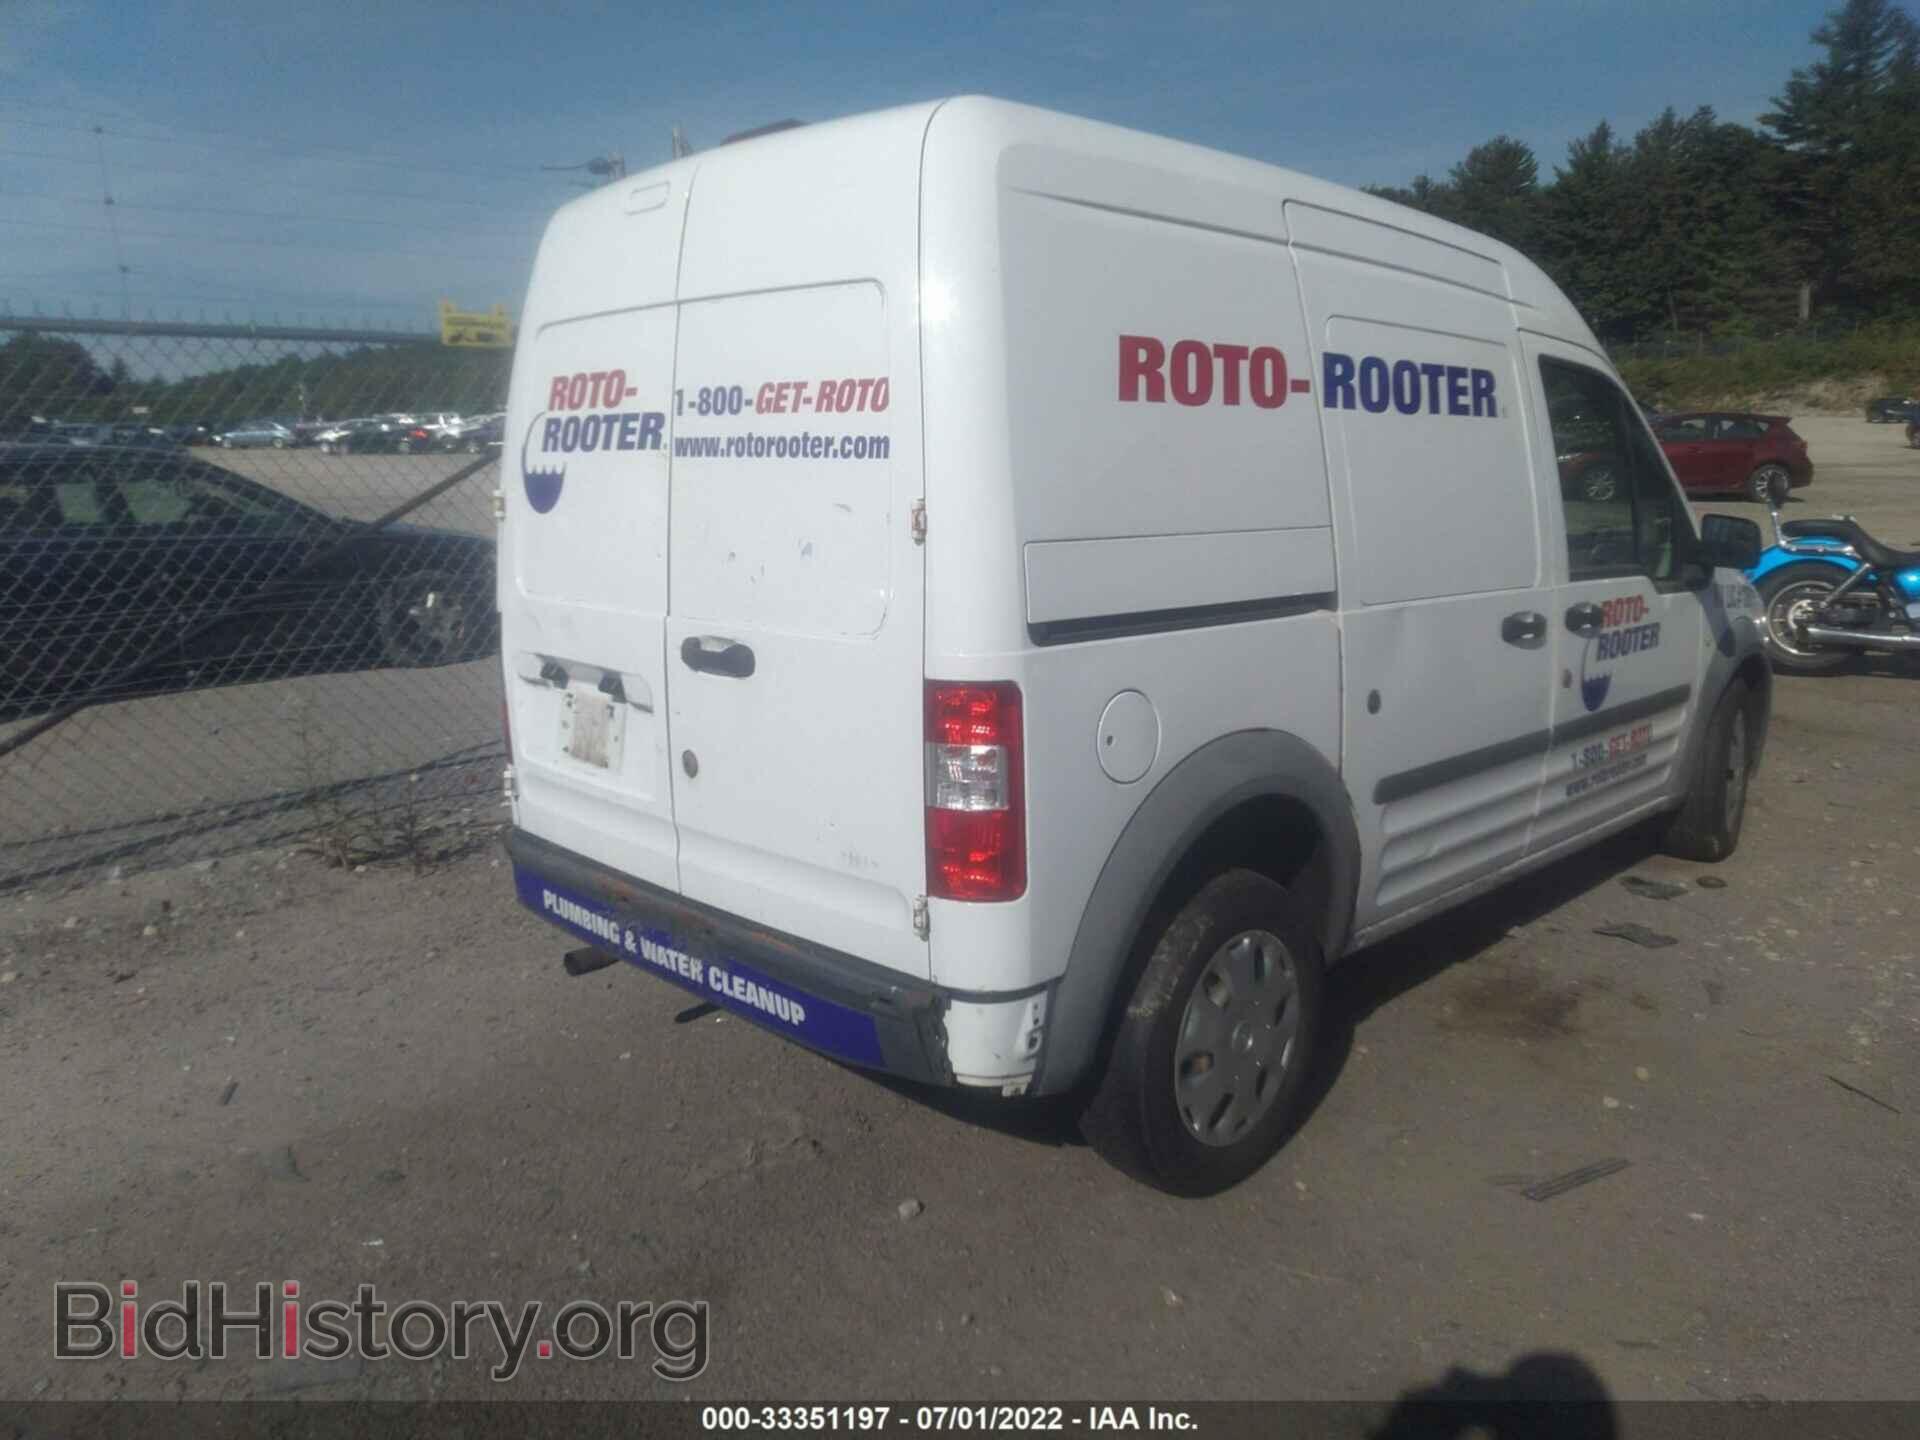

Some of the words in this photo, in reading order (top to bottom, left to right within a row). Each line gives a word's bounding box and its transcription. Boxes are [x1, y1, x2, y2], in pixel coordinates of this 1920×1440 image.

[548, 369, 638, 412] ROTO-
[674, 377, 890, 416] 1-800-GET-ROTO
[1119, 335, 1310, 409] ROTO-
[1322, 351, 1499, 418] ROOTER
[541, 412, 665, 452] ROOTER
[674, 431, 890, 460] www.rotorooter.com
[1600, 593, 1650, 628] ROTO-
[1596, 622, 1661, 662] ROOTER
[543, 889, 620, 944] PLUMBING
[624, 929, 637, 953] &
[640, 935, 703, 984] WATER
[708, 965, 806, 1026] CLEANUP
